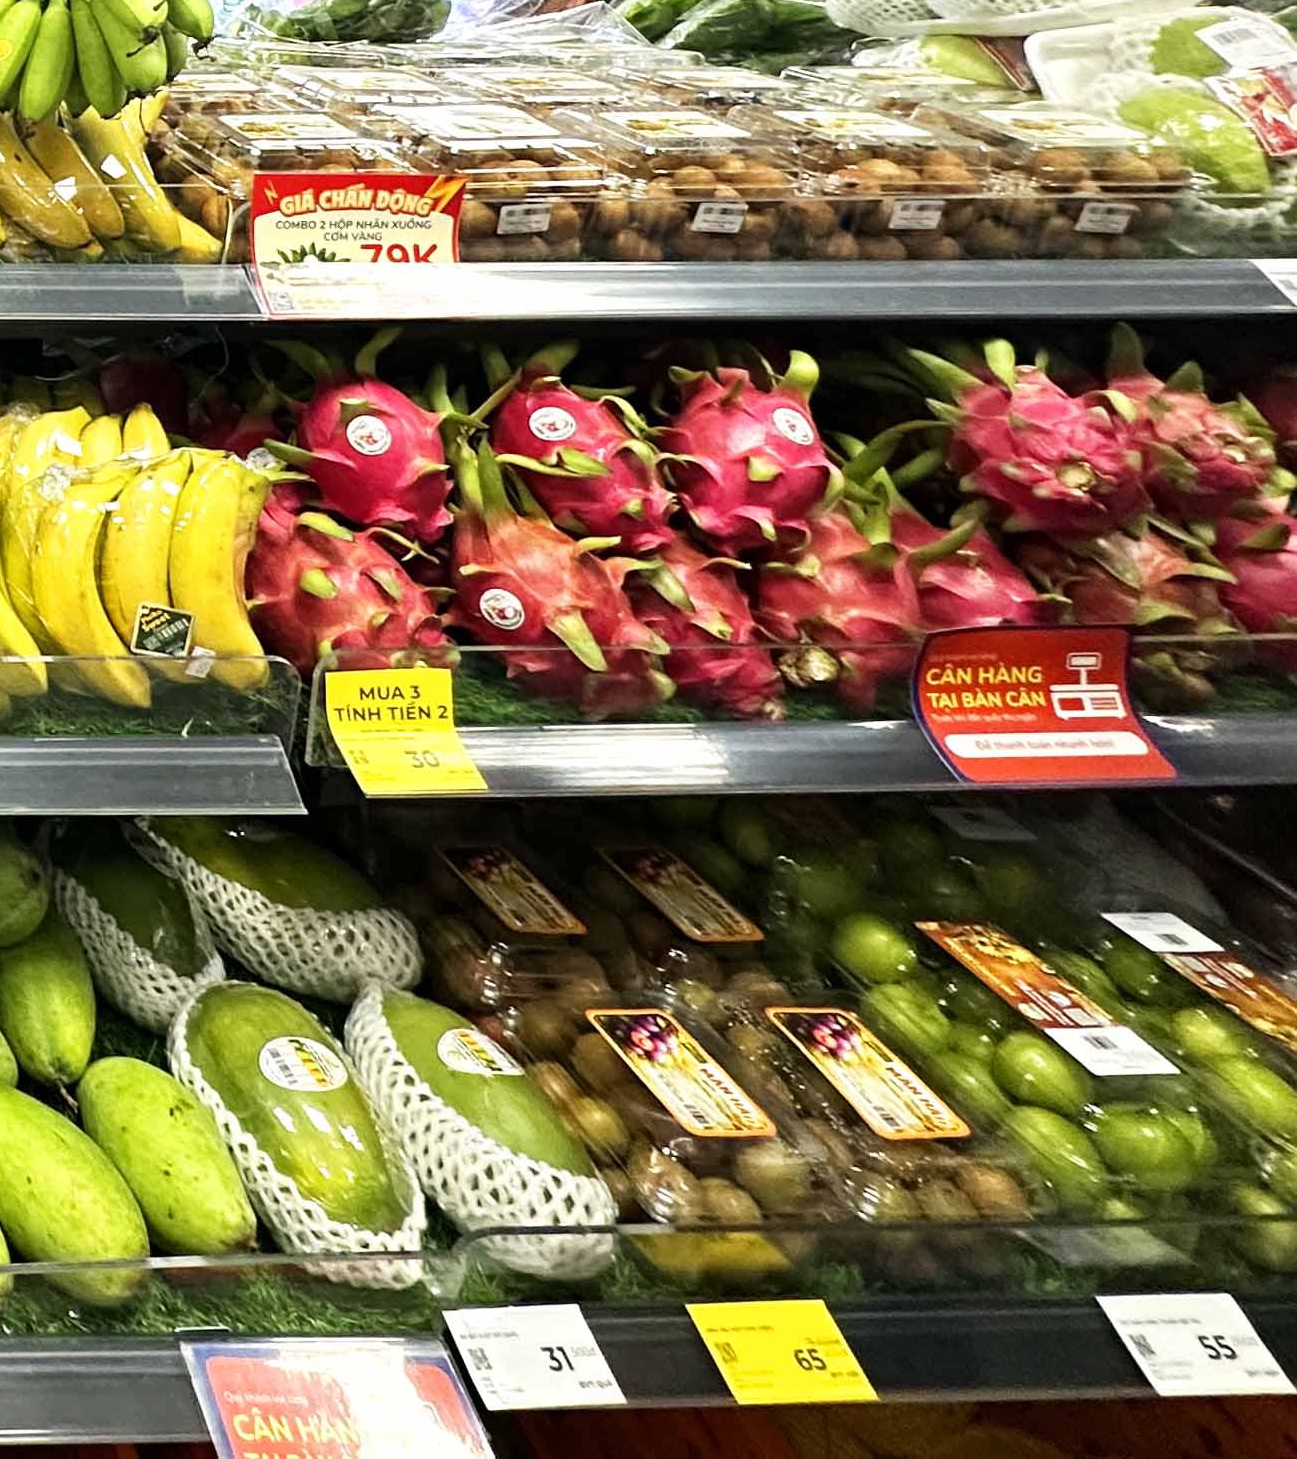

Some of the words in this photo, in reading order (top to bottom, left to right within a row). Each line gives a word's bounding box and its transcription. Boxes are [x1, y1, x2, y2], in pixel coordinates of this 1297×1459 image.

[280, 189, 317, 215] GIÁ
[318, 184, 373, 210] CHẤN
[375, 189, 433, 216] ĐỘNG
[276, 220, 316, 230] COMBO
[926, 663, 971, 685] CÂN
[978, 662, 1043, 684] HÀNG
[360, 686, 405, 700] MUA
[410, 686, 420, 699] 3
[926, 693, 958, 713] TẠI
[962, 688, 1003, 707] BÀN
[1006, 687, 1047, 707] CÂN
[334, 706, 381, 722] TÍNH
[388, 702, 431, 720] TIỀN
[438, 706, 448, 719] 2
[539, 1346, 576, 1372] 31
[793, 1348, 827, 1371] 65
[1197, 1335, 1237, 1360] 55
[233, 1408, 294, 1442] CÂN
